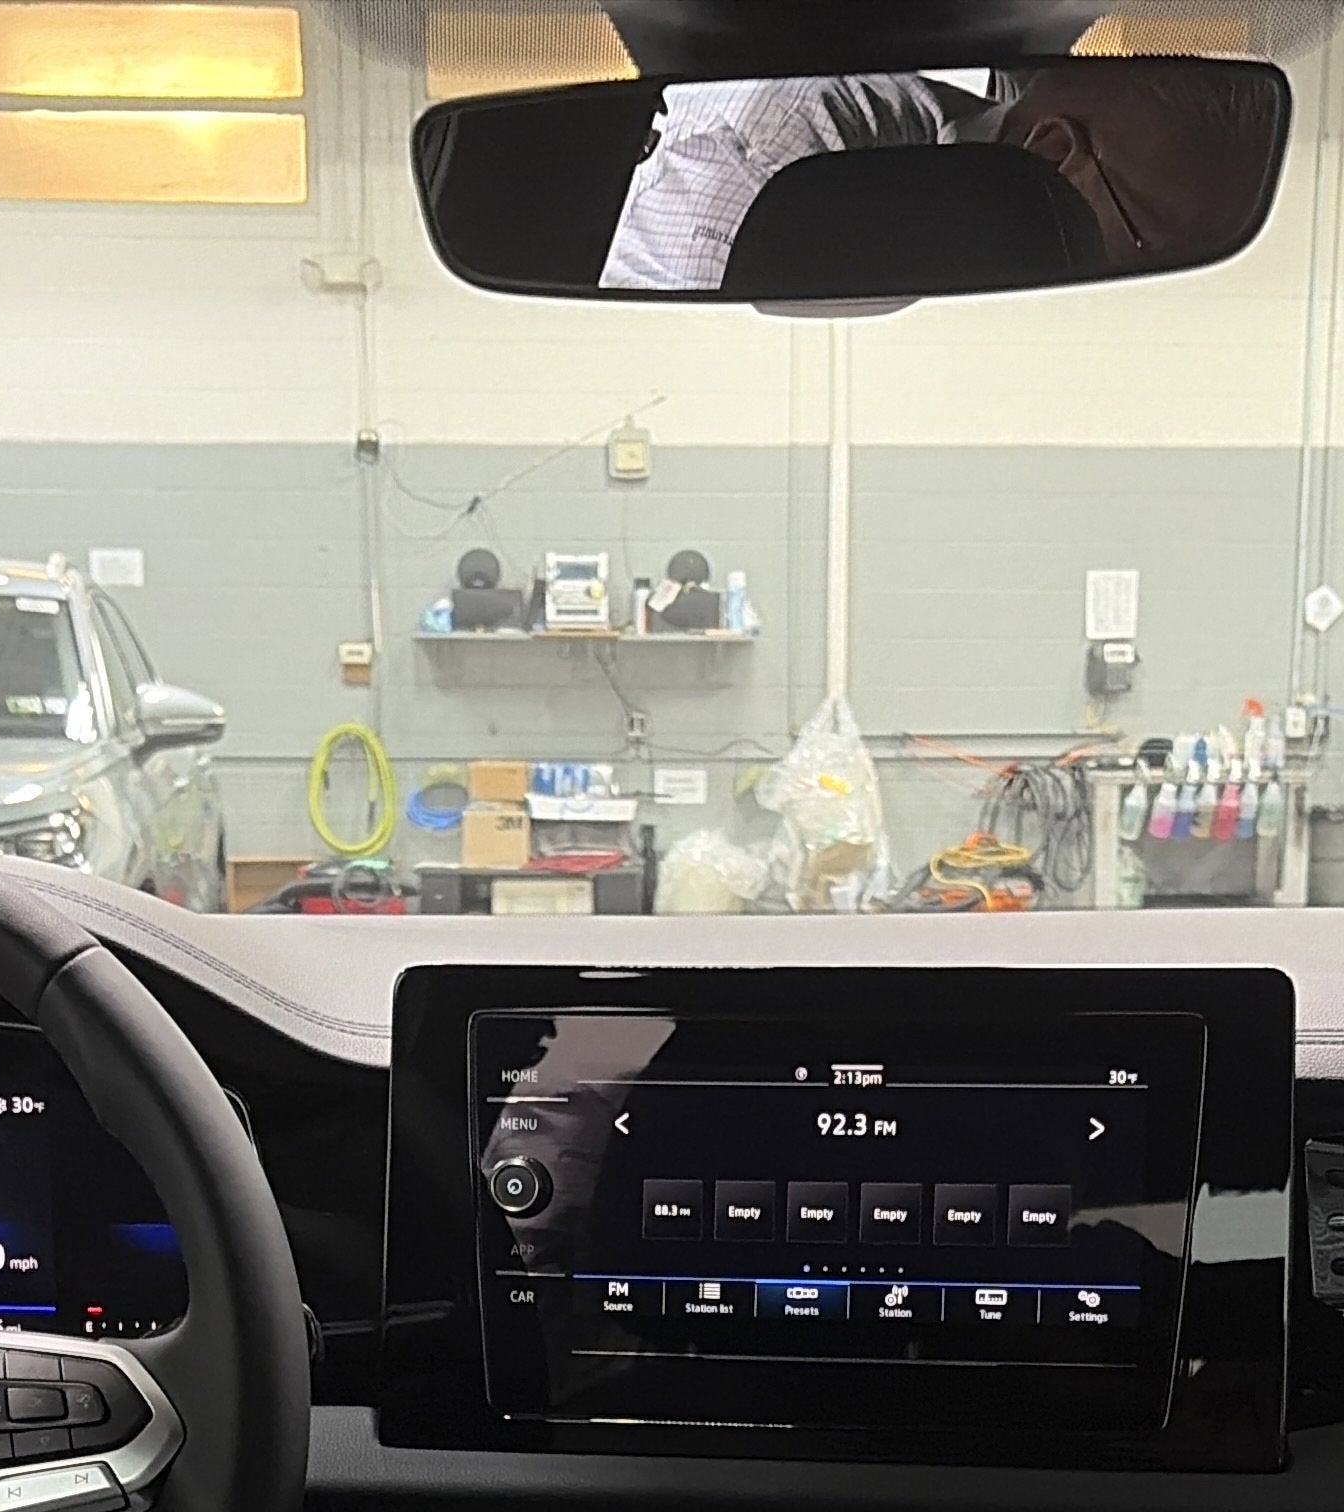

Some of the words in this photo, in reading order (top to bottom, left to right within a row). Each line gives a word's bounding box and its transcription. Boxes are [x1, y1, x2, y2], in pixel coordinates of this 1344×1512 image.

[501, 1069, 538, 1083] HOME
[833, 1071, 883, 1088] 2:13pm
[500, 1117, 538, 1131] MENU
[817, 1112, 867, 1136] 92.3
[873, 1120, 897, 1136] FM
[728, 1205, 761, 1221] Empty
[800, 1206, 834, 1222] Empty
[873, 1207, 907, 1223] Empty
[947, 1208, 981, 1224] Empty
[1022, 1209, 1056, 1225] Empty
[510, 1244, 534, 1257] APP
[9, 1256, 39, 1273] mph
[509, 1290, 534, 1304] CAR
[608, 1282, 629, 1298] FM
[603, 1300, 633, 1312] Source
[684, 1302, 717, 1315] Station
[783, 1304, 820, 1317] Presets
[878, 1306, 912, 1319] Station
[979, 1309, 1002, 1321] Tune
[1068, 1310, 1108, 1325] Settings
